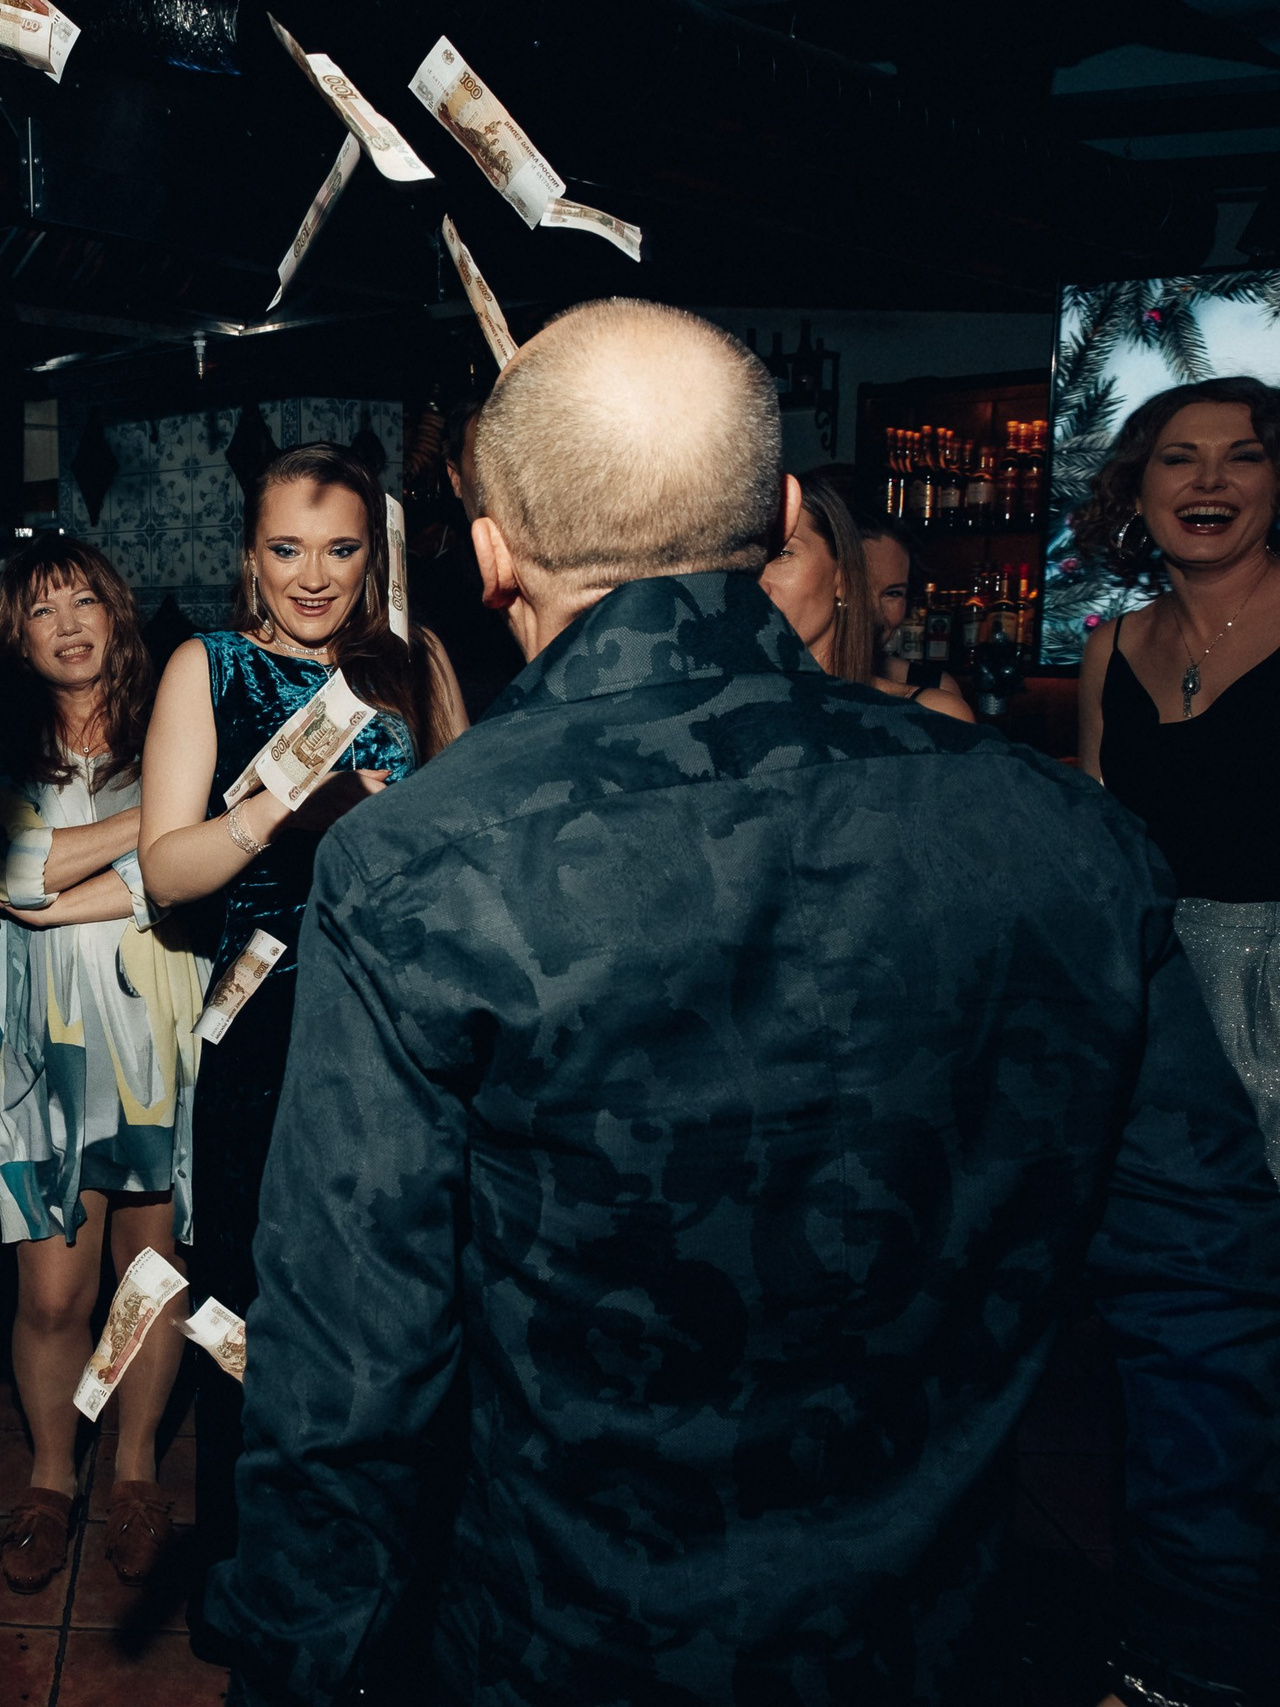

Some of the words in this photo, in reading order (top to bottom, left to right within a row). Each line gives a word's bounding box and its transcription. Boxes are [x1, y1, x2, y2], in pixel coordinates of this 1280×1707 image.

[21, 18, 40, 32] 100
[322, 74, 359, 101] 100
[459, 70, 483, 101] 100
[503, 119, 523, 142] БИЛЕТ
[519, 140, 540, 164] БАНКА
[537, 162, 560, 189] РОССИИ
[293, 222, 311, 258] 100
[392, 580, 404, 612] 100
[349, 710, 367, 727] 100
[271, 734, 291, 762] 100
[288, 785, 303, 802] 100
[253, 961, 270, 979] 100
